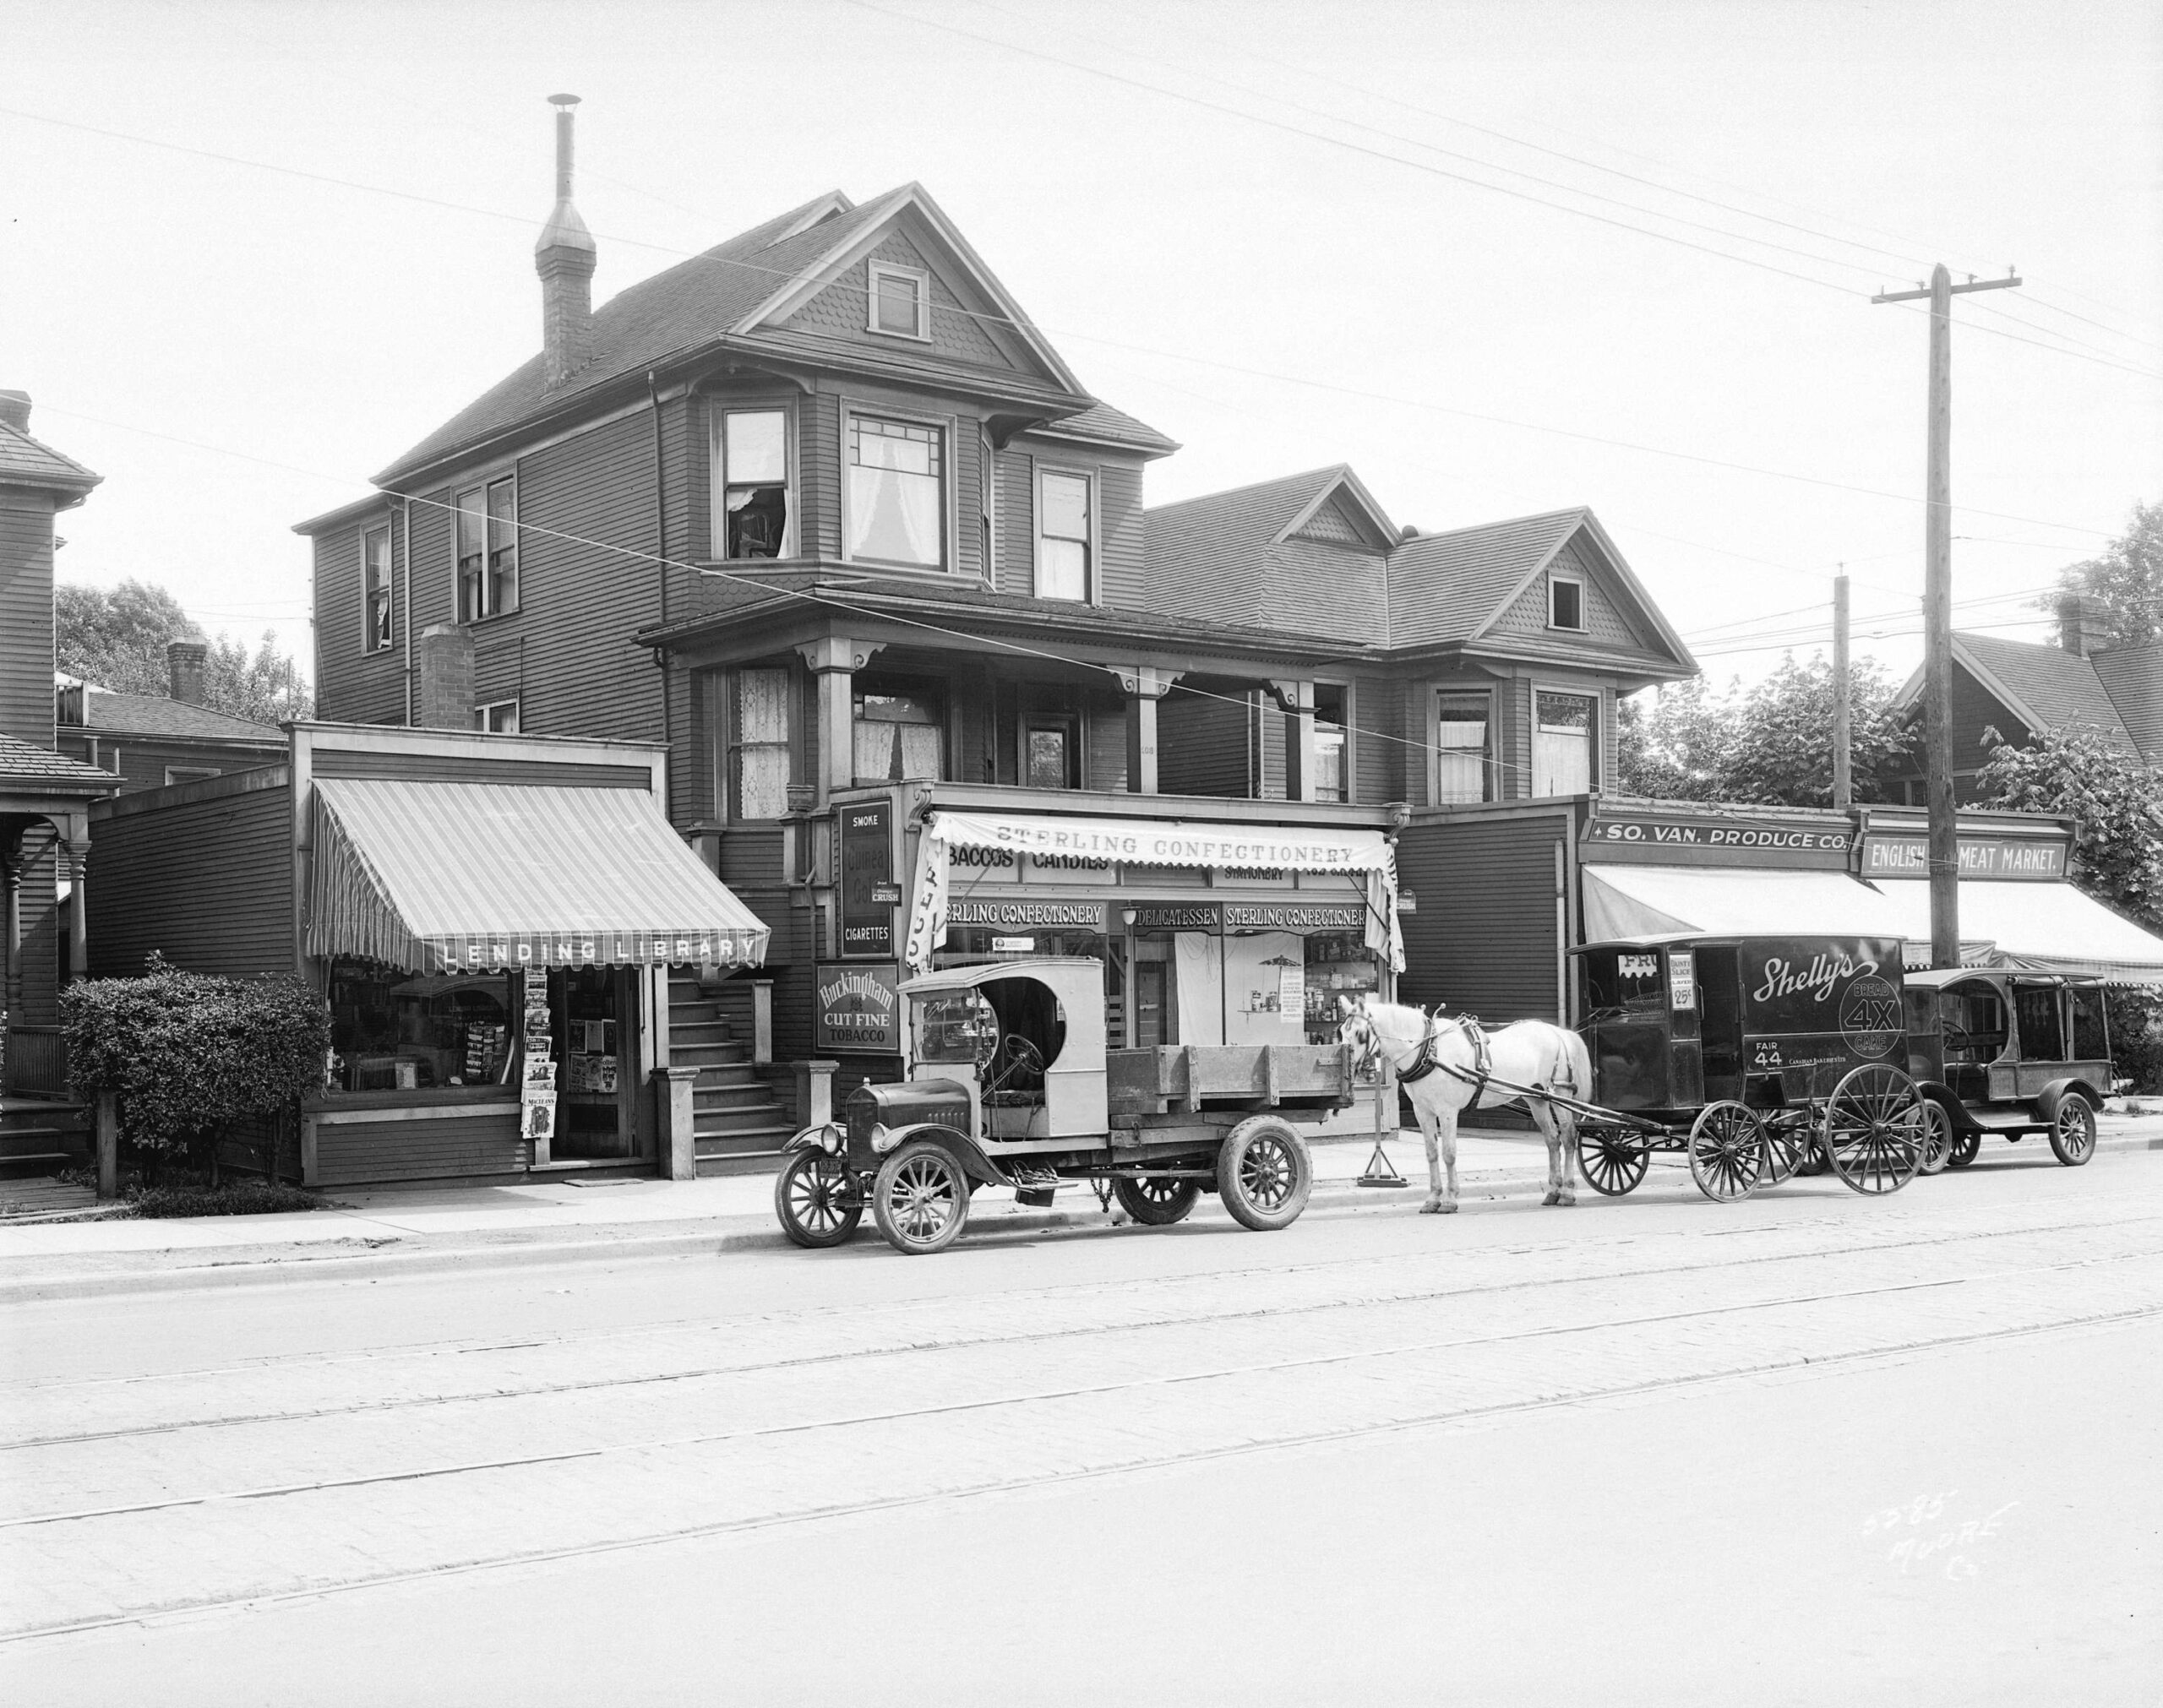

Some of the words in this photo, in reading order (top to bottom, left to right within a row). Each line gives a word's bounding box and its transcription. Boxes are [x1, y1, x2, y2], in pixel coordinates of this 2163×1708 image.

[853, 814, 879, 827] SMOKE
[997, 825, 1137, 854] STERLING
[1153, 840, 1353, 863] CONFECTIONERY
[1606, 824, 1647, 840] SO.
[1654, 825, 1702, 843] VAN.
[1709, 829, 1814, 848] PRODUCE
[1818, 834, 1848, 849] CO.
[949, 846, 1014, 868] BACCOS
[1871, 844, 1926, 868] ENGLISH
[1958, 846, 1997, 869] MEAT
[2001, 847, 2057, 870] MARKET.
[1224, 865, 1284, 880] STATIONERY
[853, 876, 874, 904] Gol
[1000, 904, 1102, 926] CONFECTIONERY
[1136, 907, 1218, 927] DELICATESSEN
[1226, 907, 1283, 927] STERLING
[1284, 908, 1366, 927] CONFECTIONER
[845, 927, 889, 941] CIGARETTES
[443, 941, 597, 963] LENDING
[617, 938, 755, 958] LIBRARY
[1670, 967, 1691, 976] SLICE
[1753, 953, 1879, 1002] Shelly's
[819, 971, 894, 1012] Buckingham
[1854, 982, 1889, 998] BREAD
[824, 1013, 853, 1025] CUT
[856, 1014, 890, 1026] FINE
[1844, 998, 1896, 1031] 4X
[830, 1029, 885, 1042] TOBACCO
[1854, 1035, 1888, 1052] CAKE
[1756, 1042, 1779, 1051] FAIR
[1754, 1051, 1783, 1067] 44
